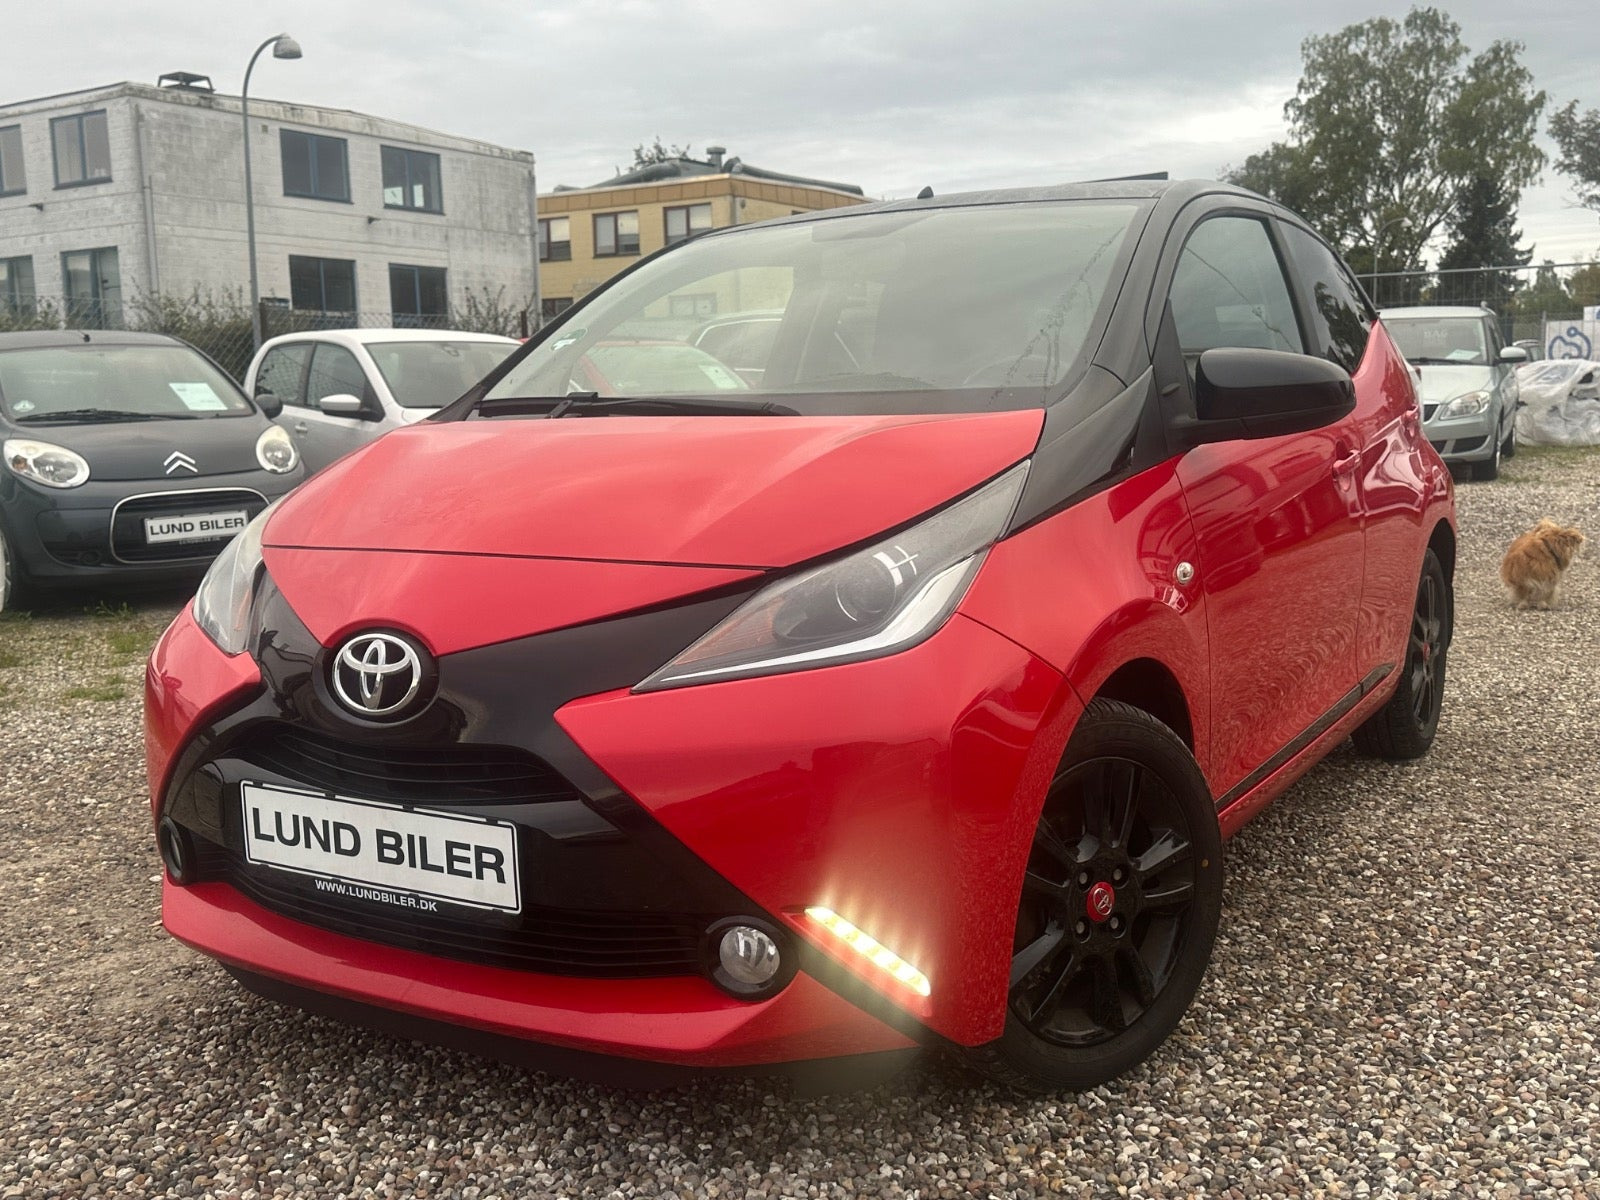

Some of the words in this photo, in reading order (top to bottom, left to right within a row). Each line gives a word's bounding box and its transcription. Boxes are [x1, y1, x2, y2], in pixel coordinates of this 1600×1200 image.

[149, 522, 194, 535] LUND
[199, 517, 245, 531] BILER
[252, 807, 361, 857] LUND
[375, 828, 506, 884] BILER
[315, 879, 438, 912] WWW.LUNDBILER.DK
